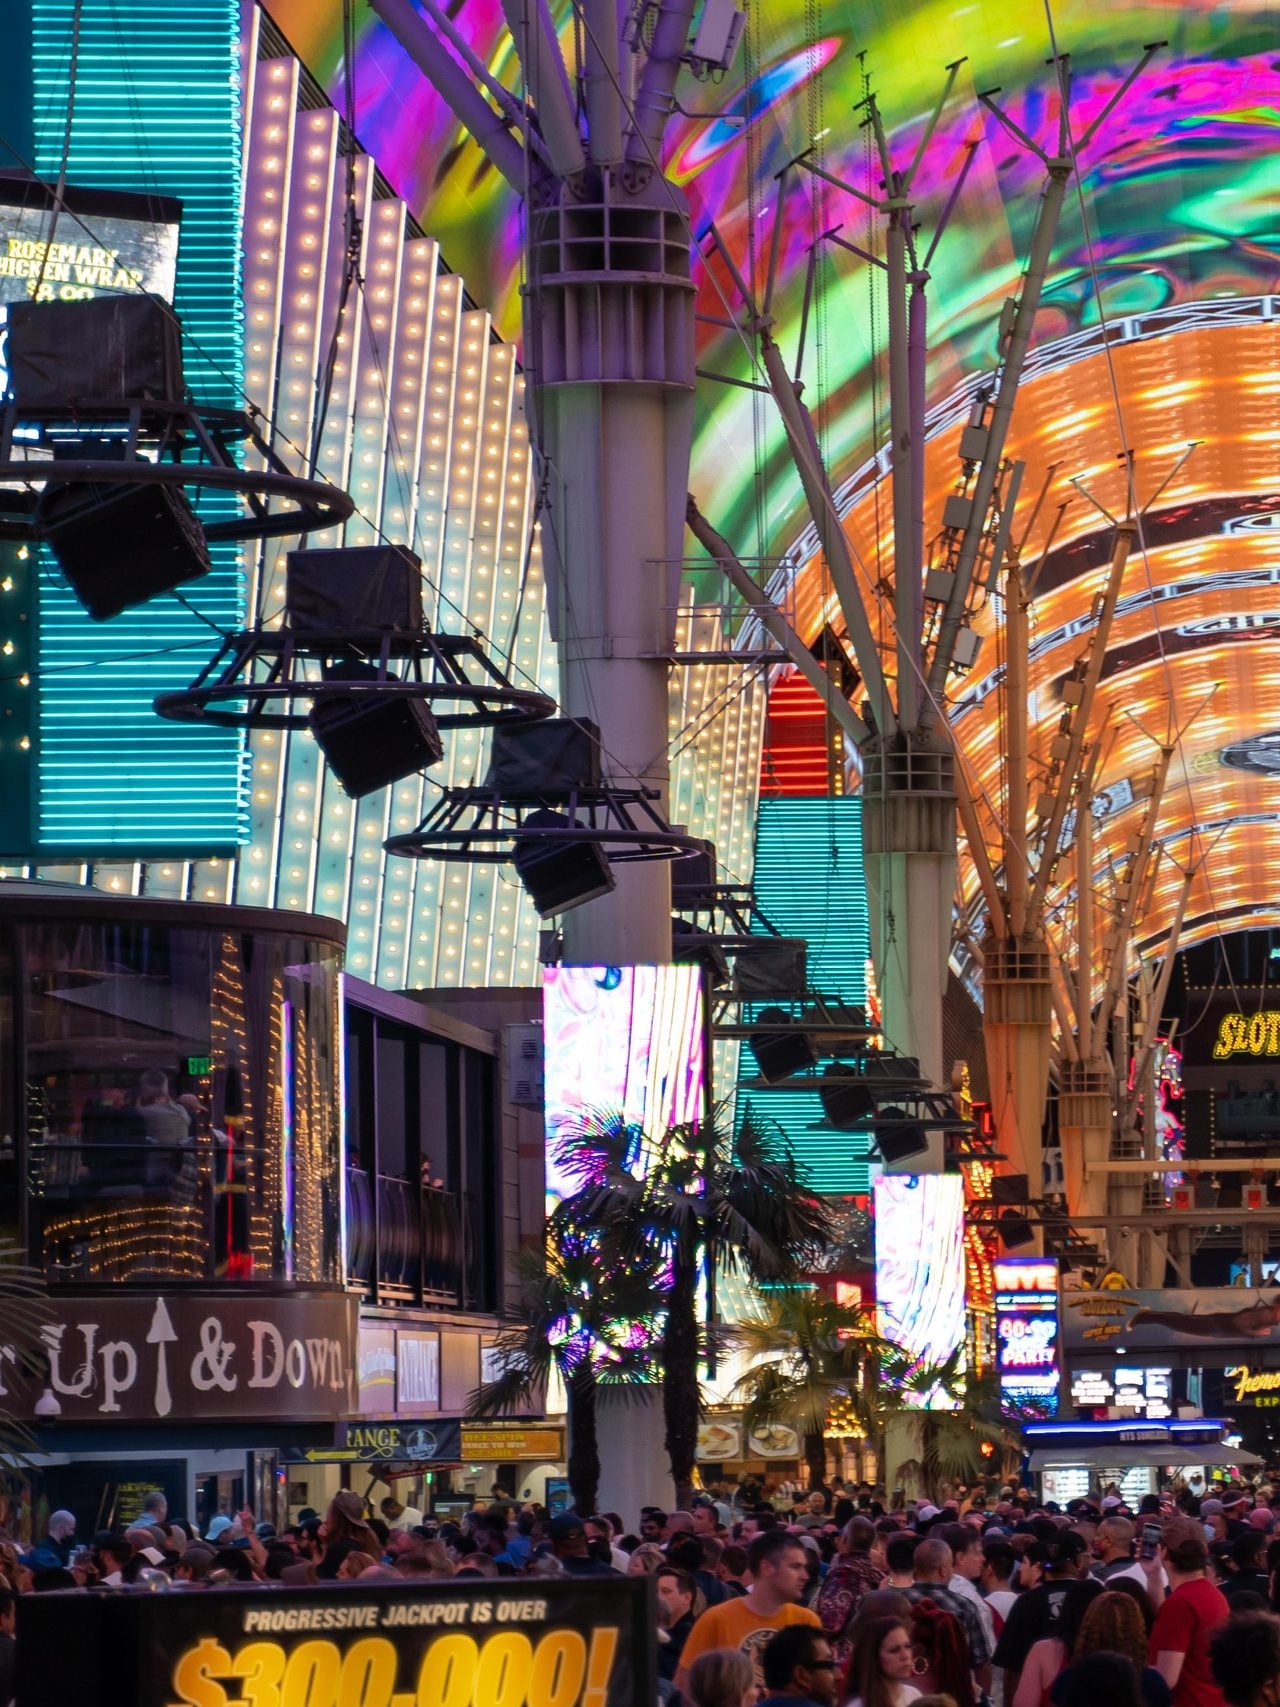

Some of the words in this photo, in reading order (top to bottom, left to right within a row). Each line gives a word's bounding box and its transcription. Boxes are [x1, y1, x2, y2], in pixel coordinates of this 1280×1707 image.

[8, 238, 119, 268] ROSEMARY
[73, 263, 144, 289] WRAP
[994, 1265, 1058, 1290] NYE
[40, 1322, 137, 1412] Up
[190, 1315, 238, 1391] &
[247, 1321, 346, 1392] Down
[1001, 1347, 1056, 1366] PARTY
[244, 1606, 377, 1632] PROGRESSIVE
[382, 1602, 467, 1626] JACKPOT
[471, 1602, 492, 1622] IS
[496, 1599, 547, 1621] OVER
